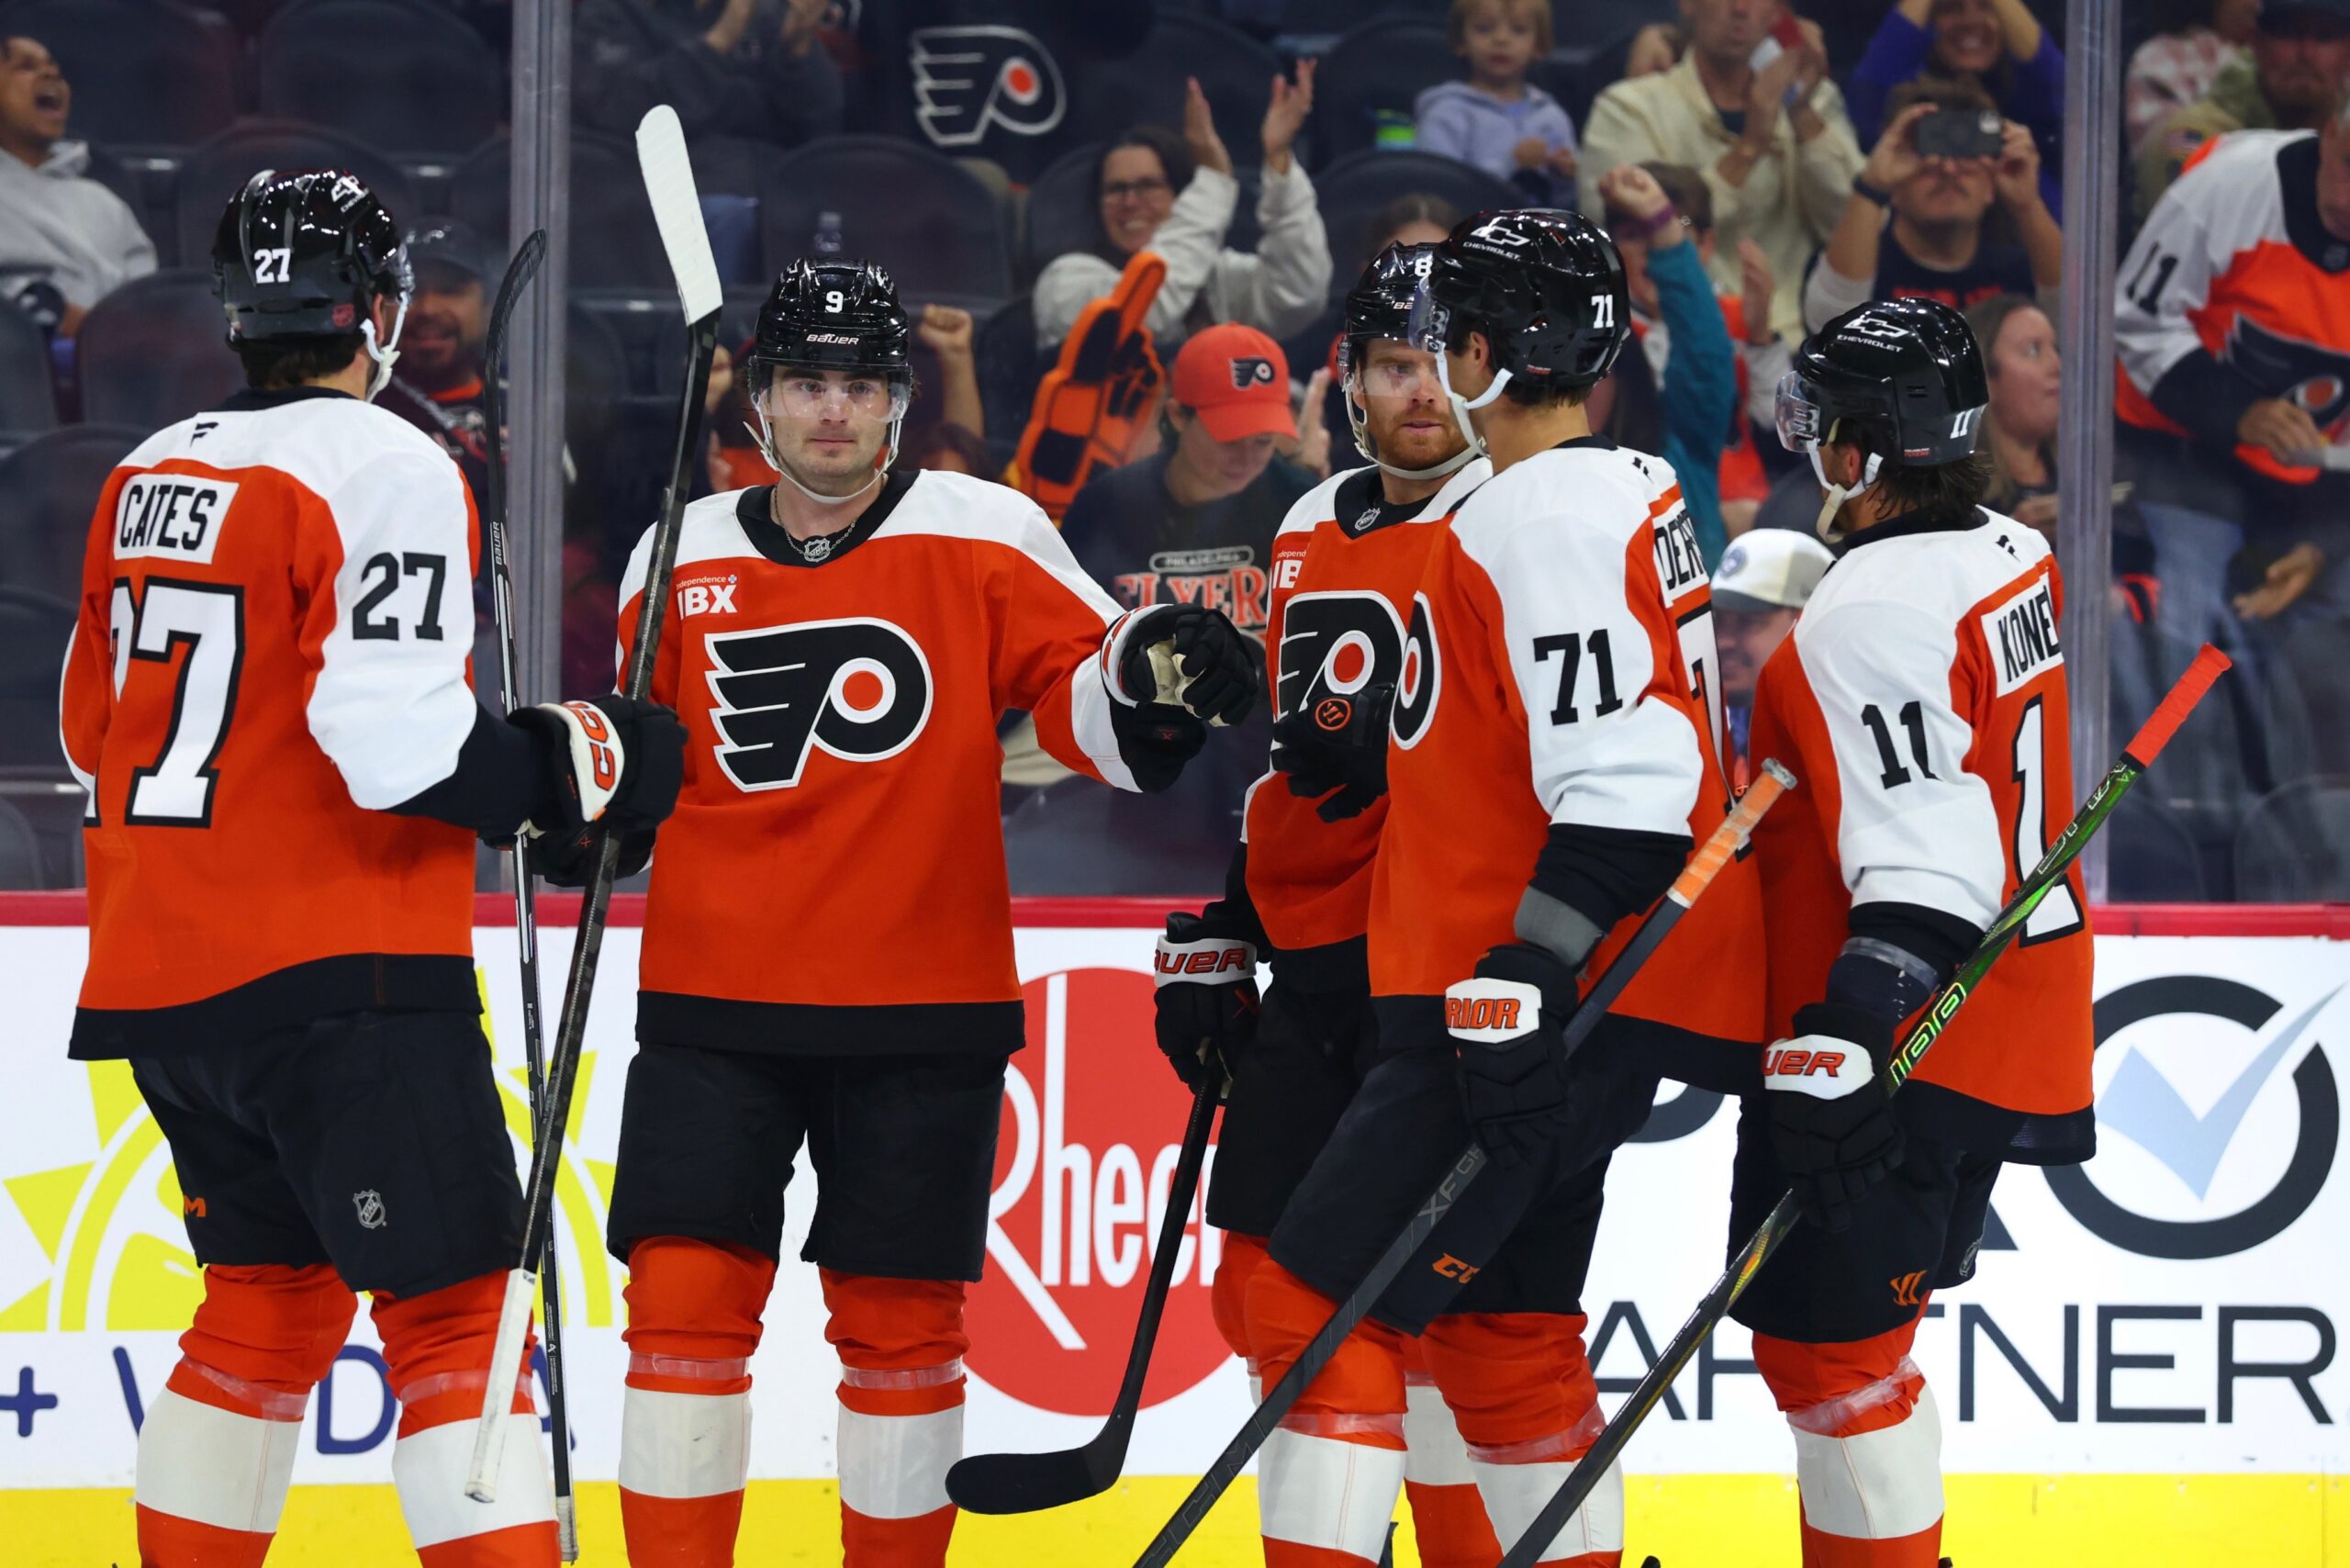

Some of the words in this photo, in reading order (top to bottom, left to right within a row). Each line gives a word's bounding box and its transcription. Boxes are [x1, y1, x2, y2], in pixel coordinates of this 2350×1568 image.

[253, 248, 291, 284] 27
[1415, 258, 1432, 275] 8
[1463, 241, 1521, 260] CHEVROLET
[2125, 241, 2178, 317] 11
[826, 291, 844, 313] 9
[1591, 295, 1614, 329] 71
[806, 334, 859, 345] BAUER
[1837, 334, 1904, 353] CHEVROLET
[1950, 409, 1974, 439] 11
[119, 484, 218, 551] CATES
[493, 521, 503, 566] BAUER
[352, 552, 447, 642] 27
[677, 585, 738, 621] IBX
[1998, 585, 2062, 683] KONE
[1532, 629, 1624, 725] 71
[560, 702, 616, 791] CC
[1861, 700, 1943, 790] 11
[1445, 998, 1521, 1029] RIOR
